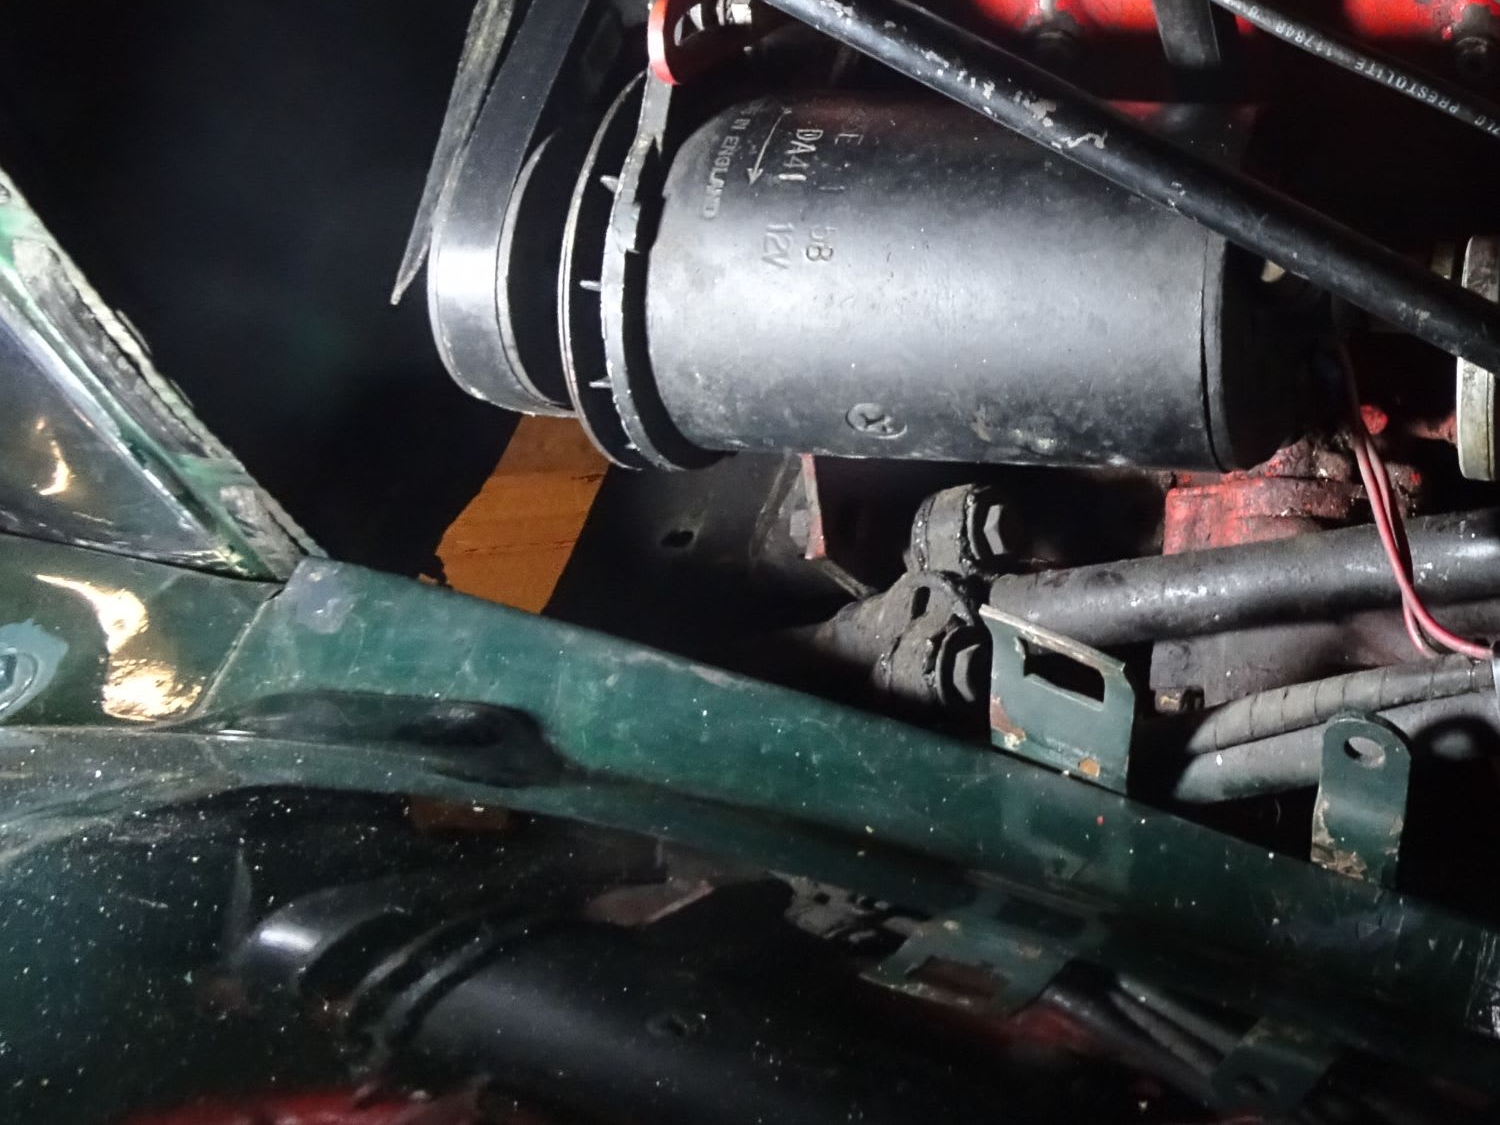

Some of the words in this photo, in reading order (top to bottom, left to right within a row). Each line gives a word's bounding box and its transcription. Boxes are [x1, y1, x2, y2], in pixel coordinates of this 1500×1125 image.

[1353, 59, 1462, 114] PRESTOLITE
[703, 135, 740, 219] ENGLAND
[762, 222, 794, 269] 12V
